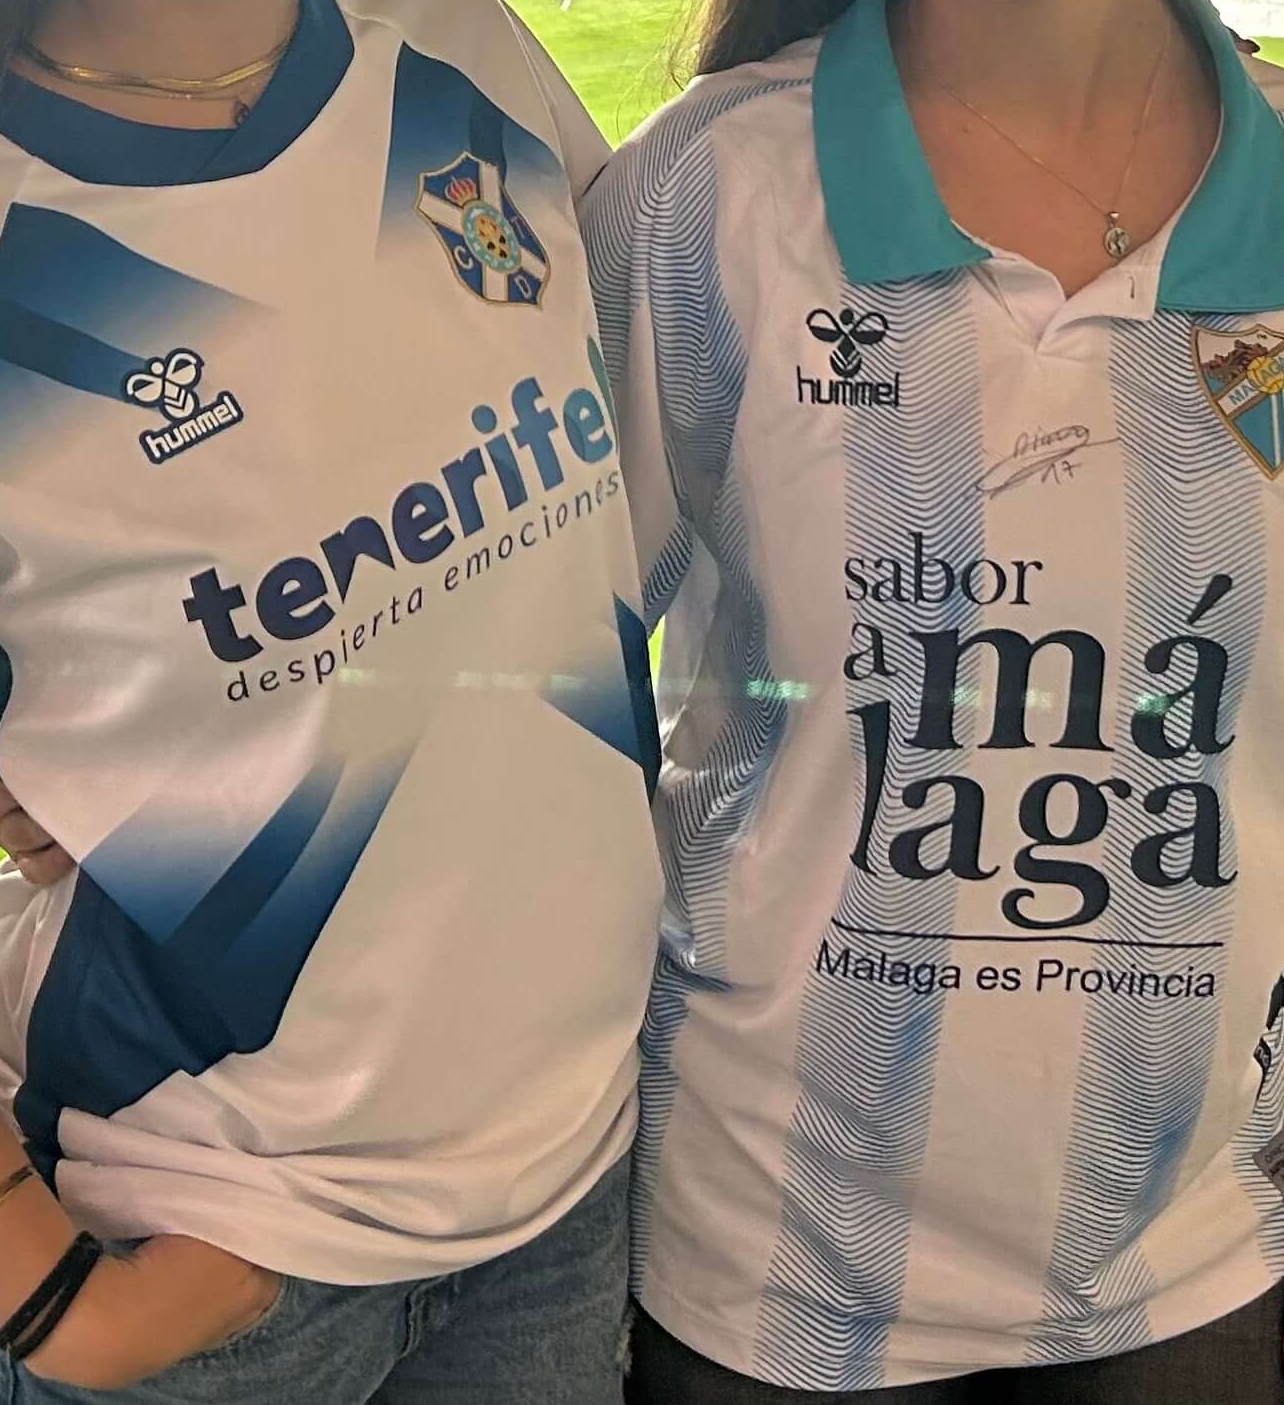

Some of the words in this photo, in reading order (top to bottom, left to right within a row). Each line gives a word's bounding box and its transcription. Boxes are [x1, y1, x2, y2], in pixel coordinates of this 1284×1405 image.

[145, 395, 240, 459] hummel
[797, 365, 900, 407] hummel
[181, 375, 614, 664] tenerife
[844, 531, 1043, 605] sabor
[226, 585, 424, 703] despierta
[443, 469, 620, 593] emociones
[843, 621, 897, 681] a
[903, 573, 1236, 761] má
[846, 699, 1238, 930] laga
[976, 966, 1021, 991] es
[1035, 957, 1216, 998] Provincia
